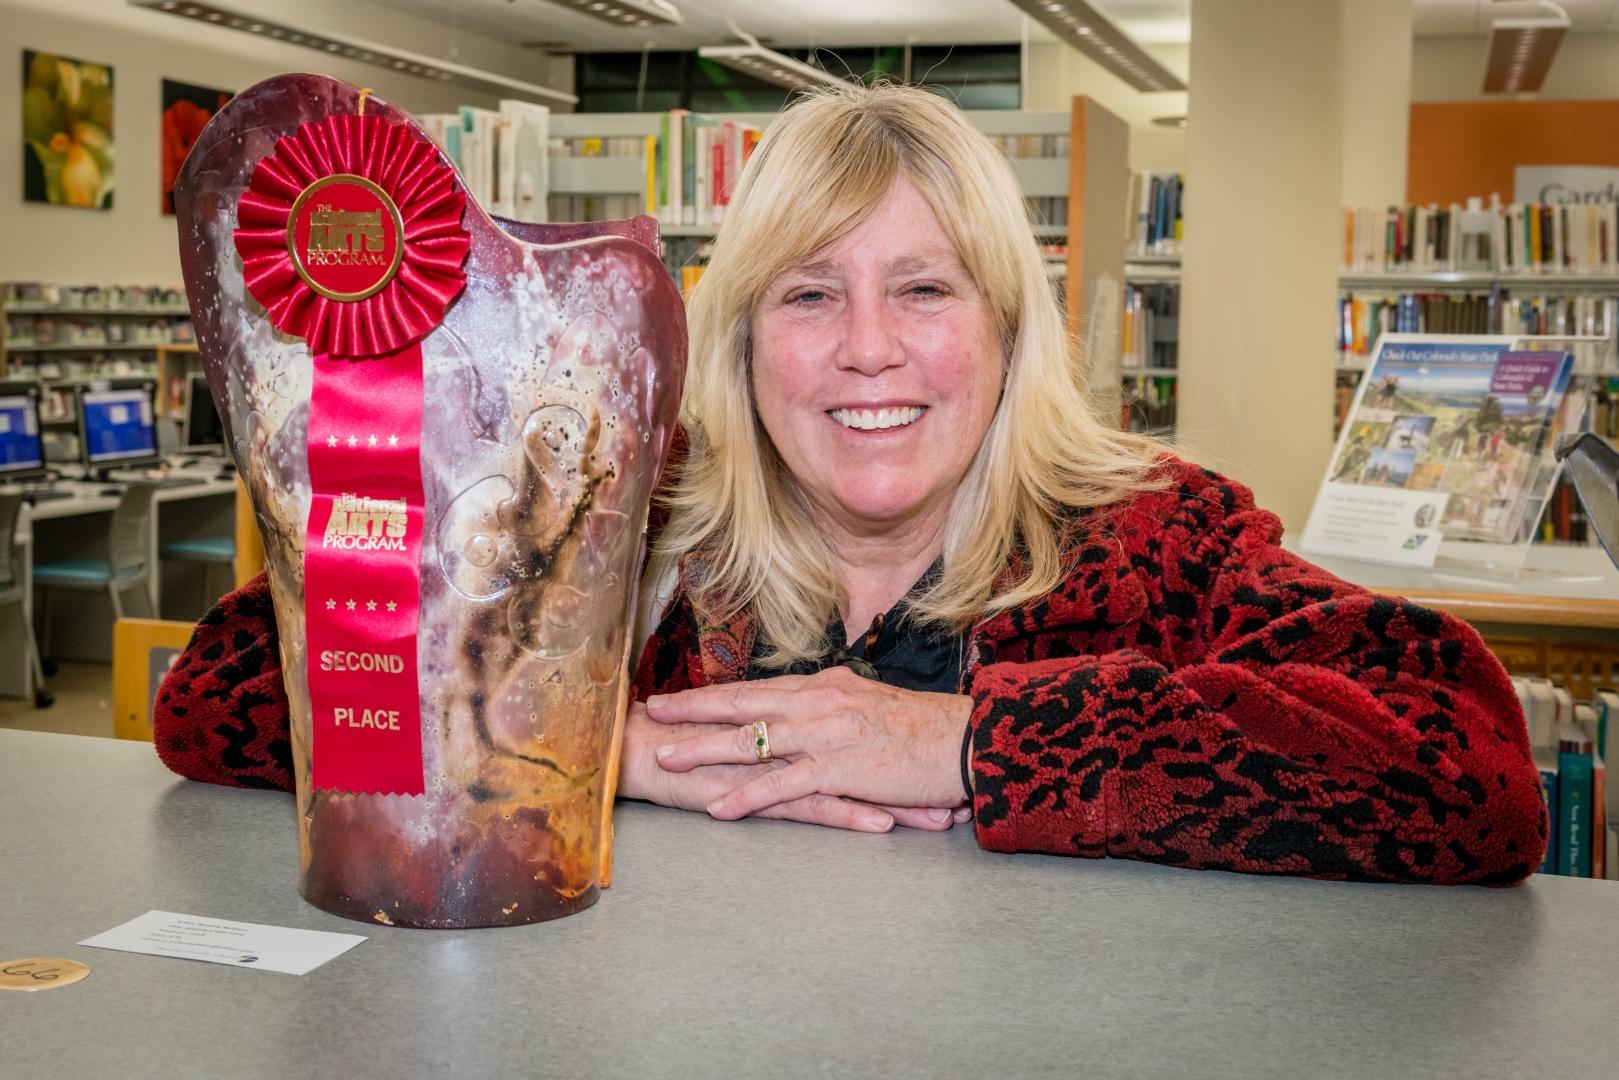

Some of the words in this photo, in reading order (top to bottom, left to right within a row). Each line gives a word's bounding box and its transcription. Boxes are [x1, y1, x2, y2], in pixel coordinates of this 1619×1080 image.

[1539, 182, 1619, 205] Gard
[317, 204, 333, 212] THE
[308, 225, 385, 252] ARTS
[324, 511, 408, 538] ARTS
[320, 650, 404, 674] SECOND
[334, 707, 401, 731] PLACE
[2, 963, 61, 980] 66
